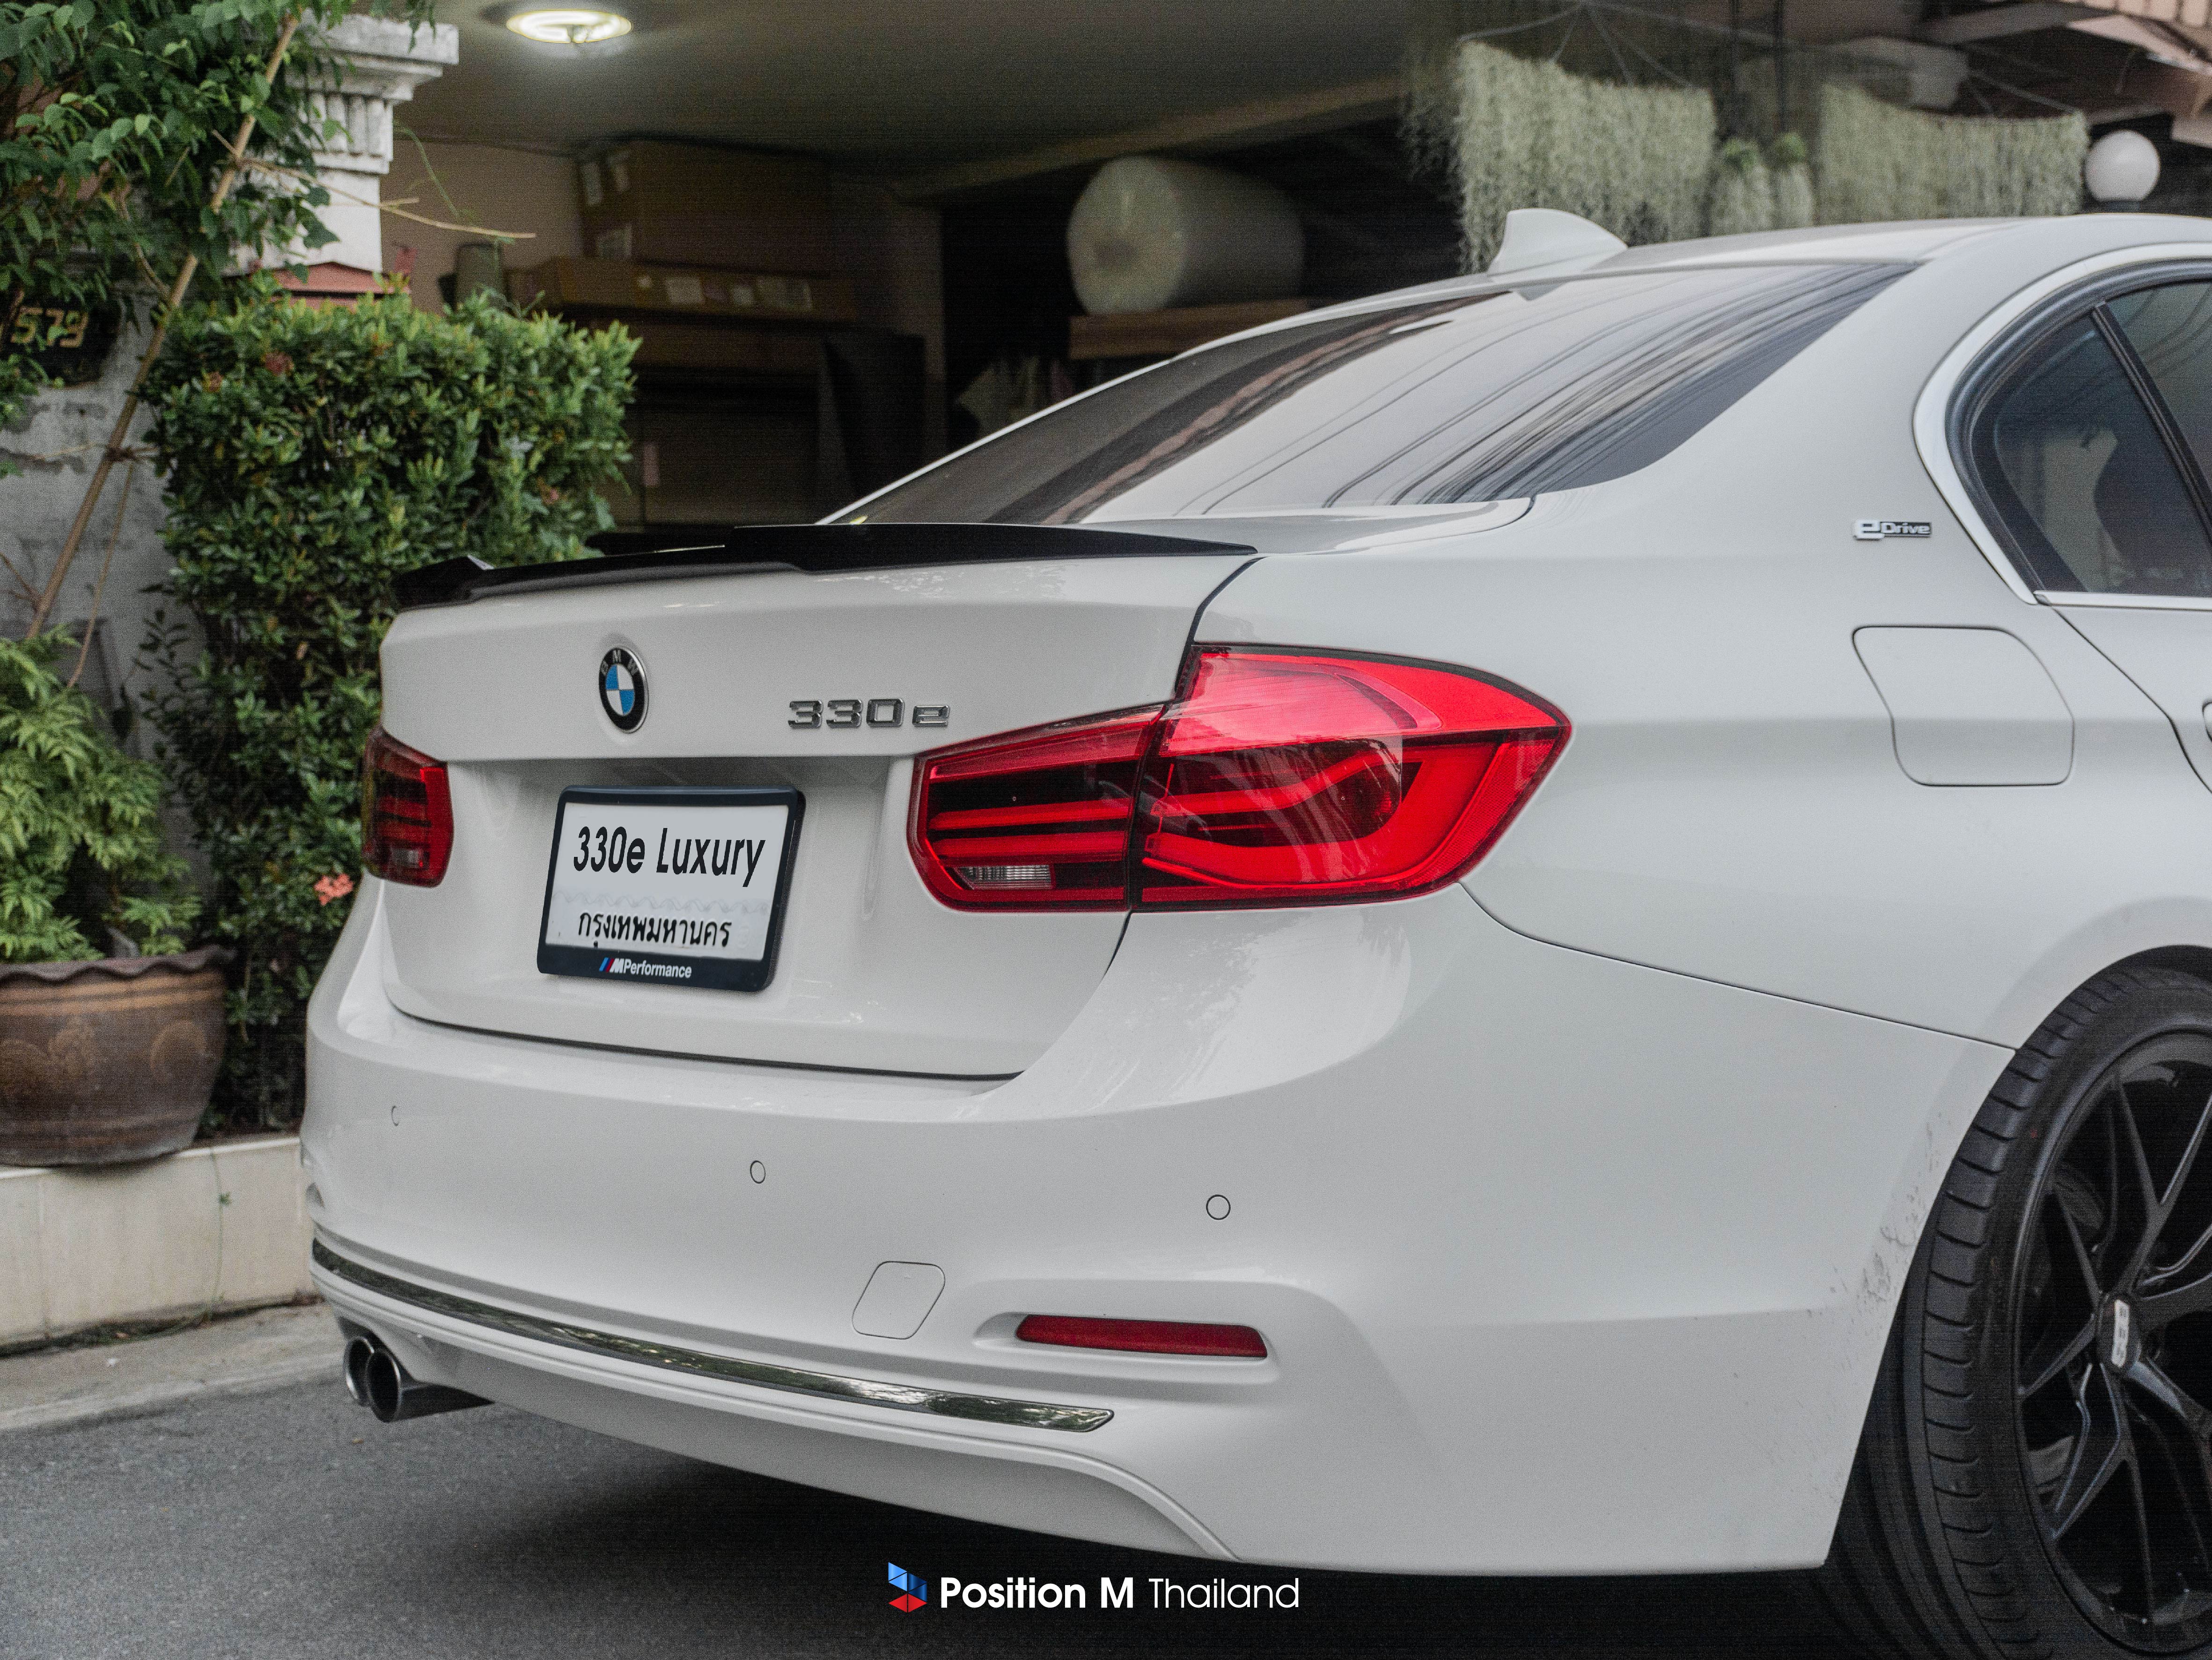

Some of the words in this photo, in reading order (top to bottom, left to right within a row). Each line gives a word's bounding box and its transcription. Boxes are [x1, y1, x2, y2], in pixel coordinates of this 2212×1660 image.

[1854, 519, 1931, 539] eDrive
[601, 649, 639, 676] BMW
[573, 826, 645, 873] 330e
[656, 828, 765, 887] Luxury
[578, 912, 732, 948] กรุงเทพมหานคร
